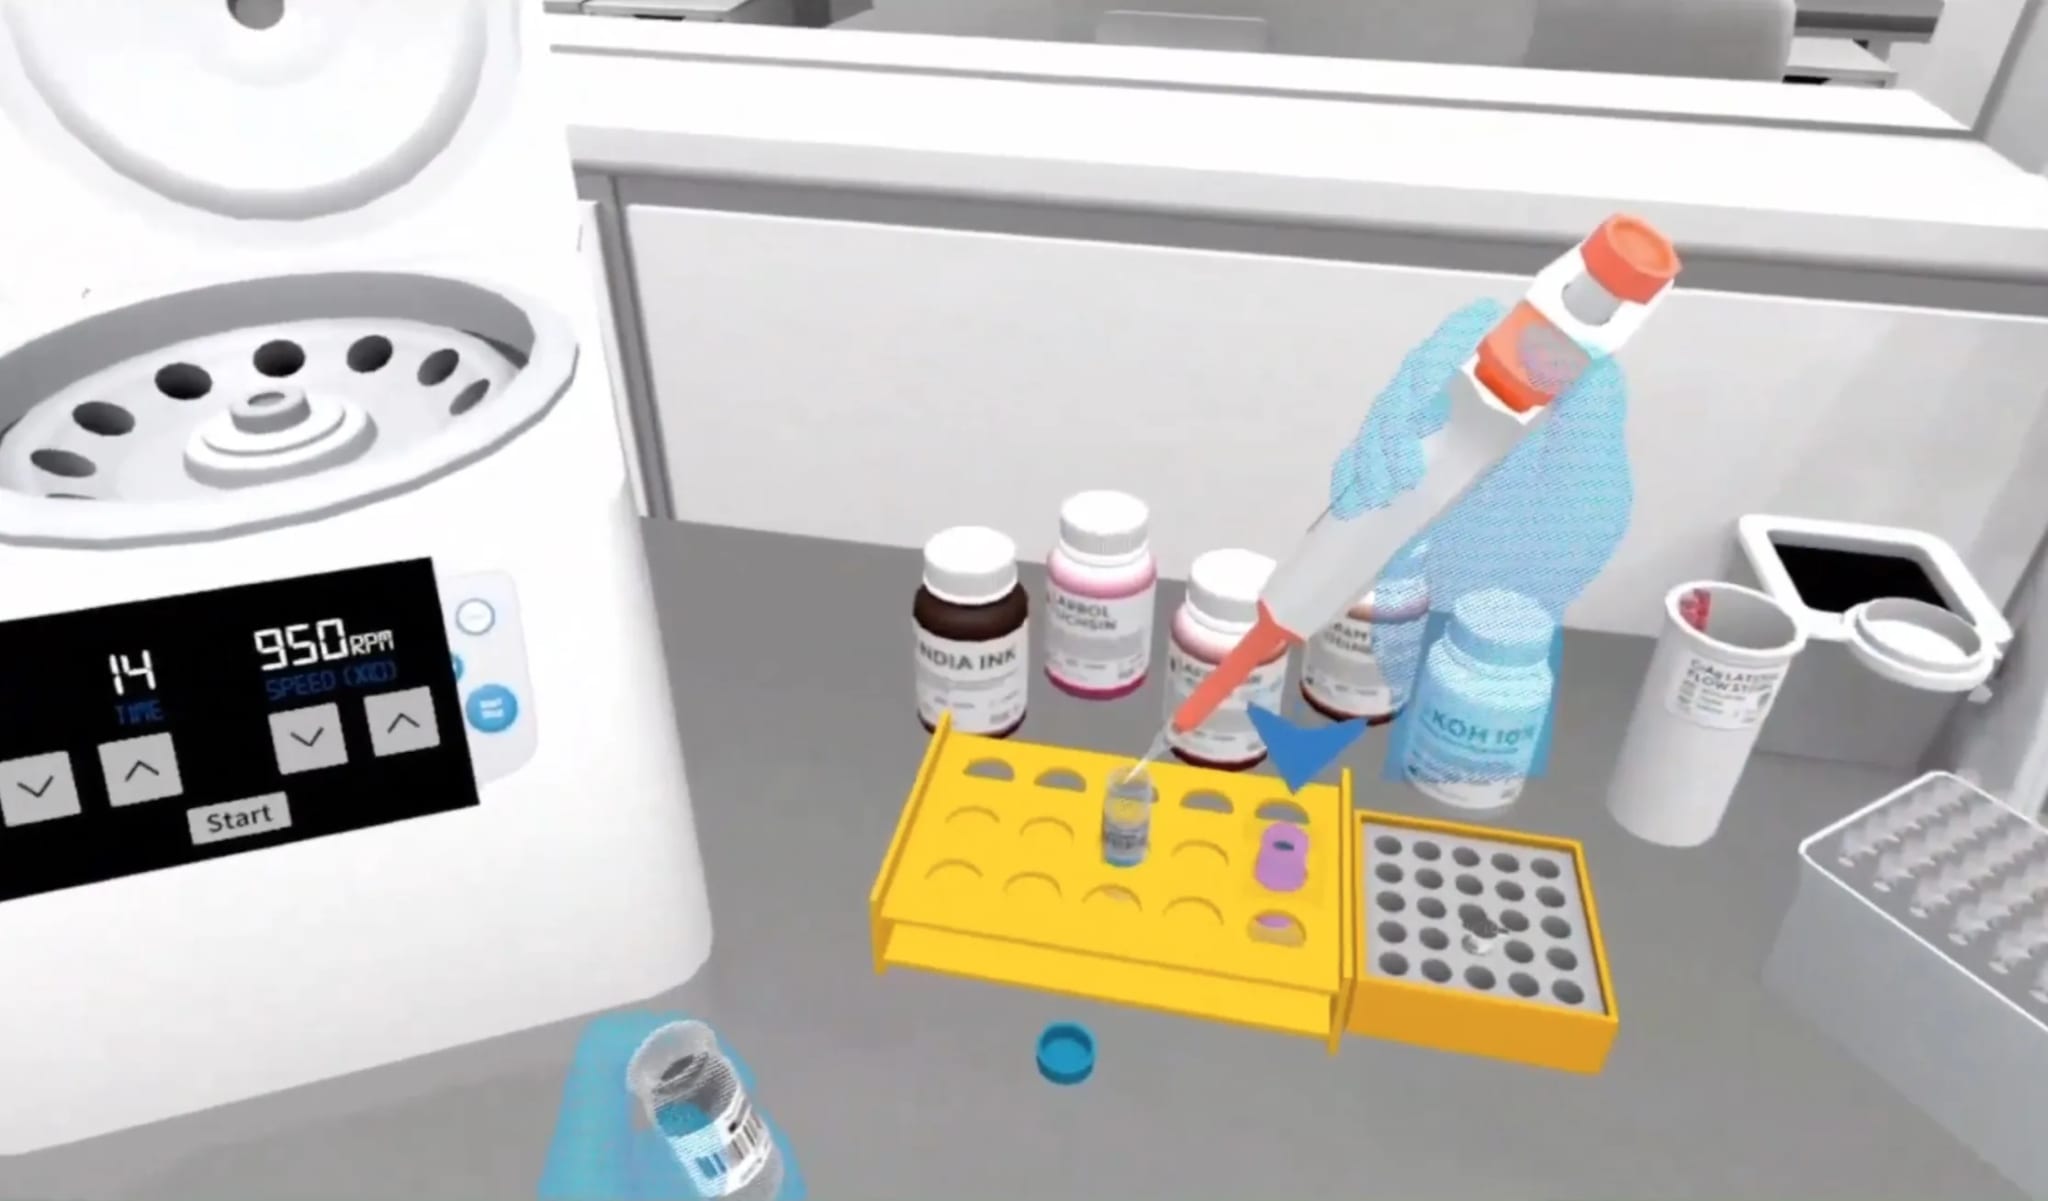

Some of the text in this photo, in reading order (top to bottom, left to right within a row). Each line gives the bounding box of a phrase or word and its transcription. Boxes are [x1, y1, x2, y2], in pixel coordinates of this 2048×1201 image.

[109, 649, 157, 696] 14
[265, 670, 336, 702] SPEED
[114, 698, 166, 726] TIME
[1432, 709, 1489, 745] KOH
[206, 804, 274, 834] Start
